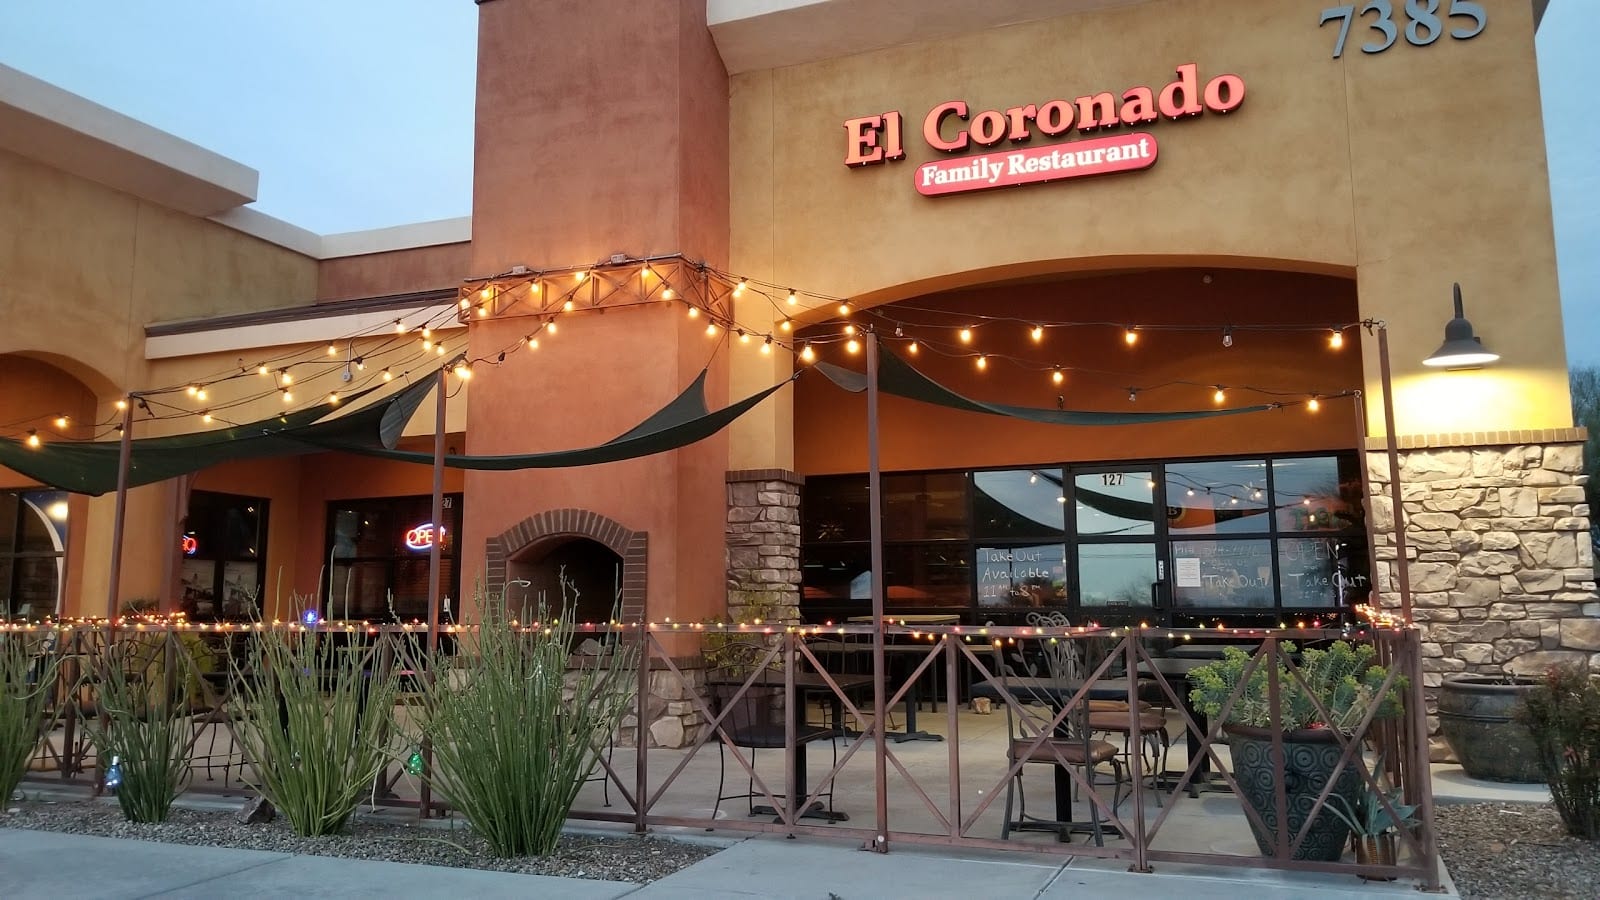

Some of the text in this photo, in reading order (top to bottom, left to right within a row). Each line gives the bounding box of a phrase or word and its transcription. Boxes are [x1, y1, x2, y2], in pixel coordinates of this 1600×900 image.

[1319, 0, 1488, 59] 7385
[844, 63, 1246, 168] El Coronado
[921, 138, 1150, 187] Family Restaurant
[1101, 473, 1123, 486] 127
[983, 551, 1042, 563] Take Out
[982, 566, 1049, 582] Available
[1287, 573, 1329, 589] Take
